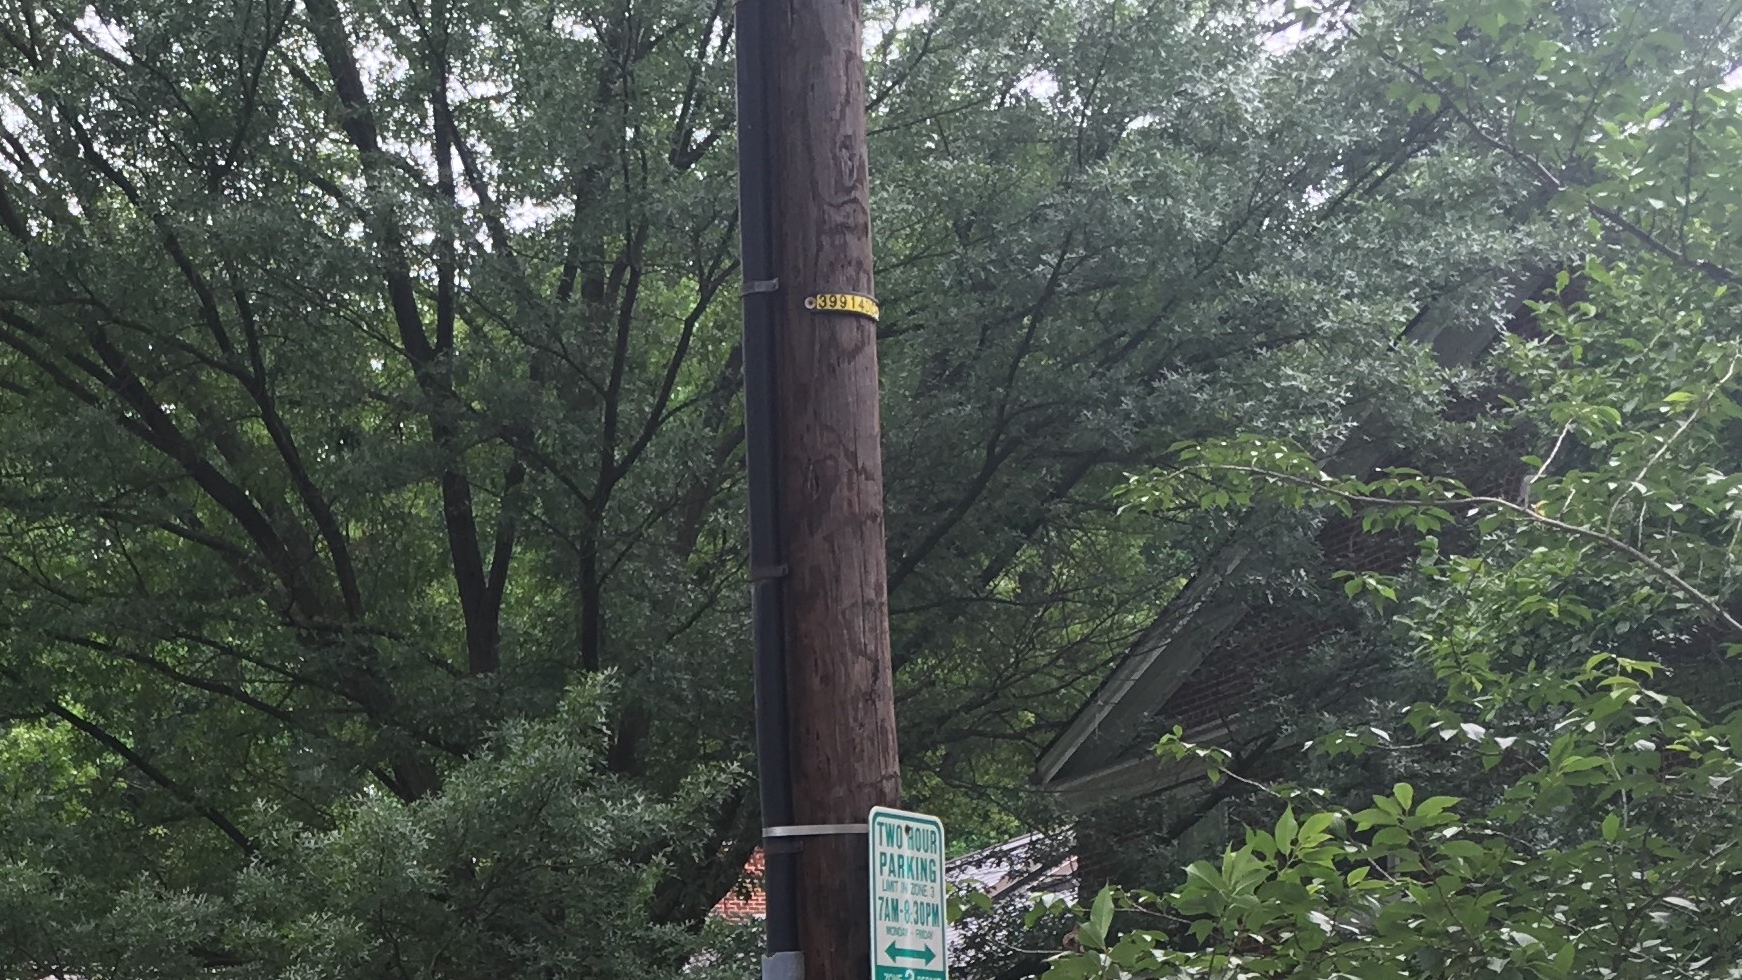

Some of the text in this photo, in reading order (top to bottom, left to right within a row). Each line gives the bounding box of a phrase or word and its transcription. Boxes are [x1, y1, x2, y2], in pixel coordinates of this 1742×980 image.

[877, 822, 937, 854] TWO HOUR
[879, 851, 937, 883] PARKING
[910, 882, 928, 897] ZONE
